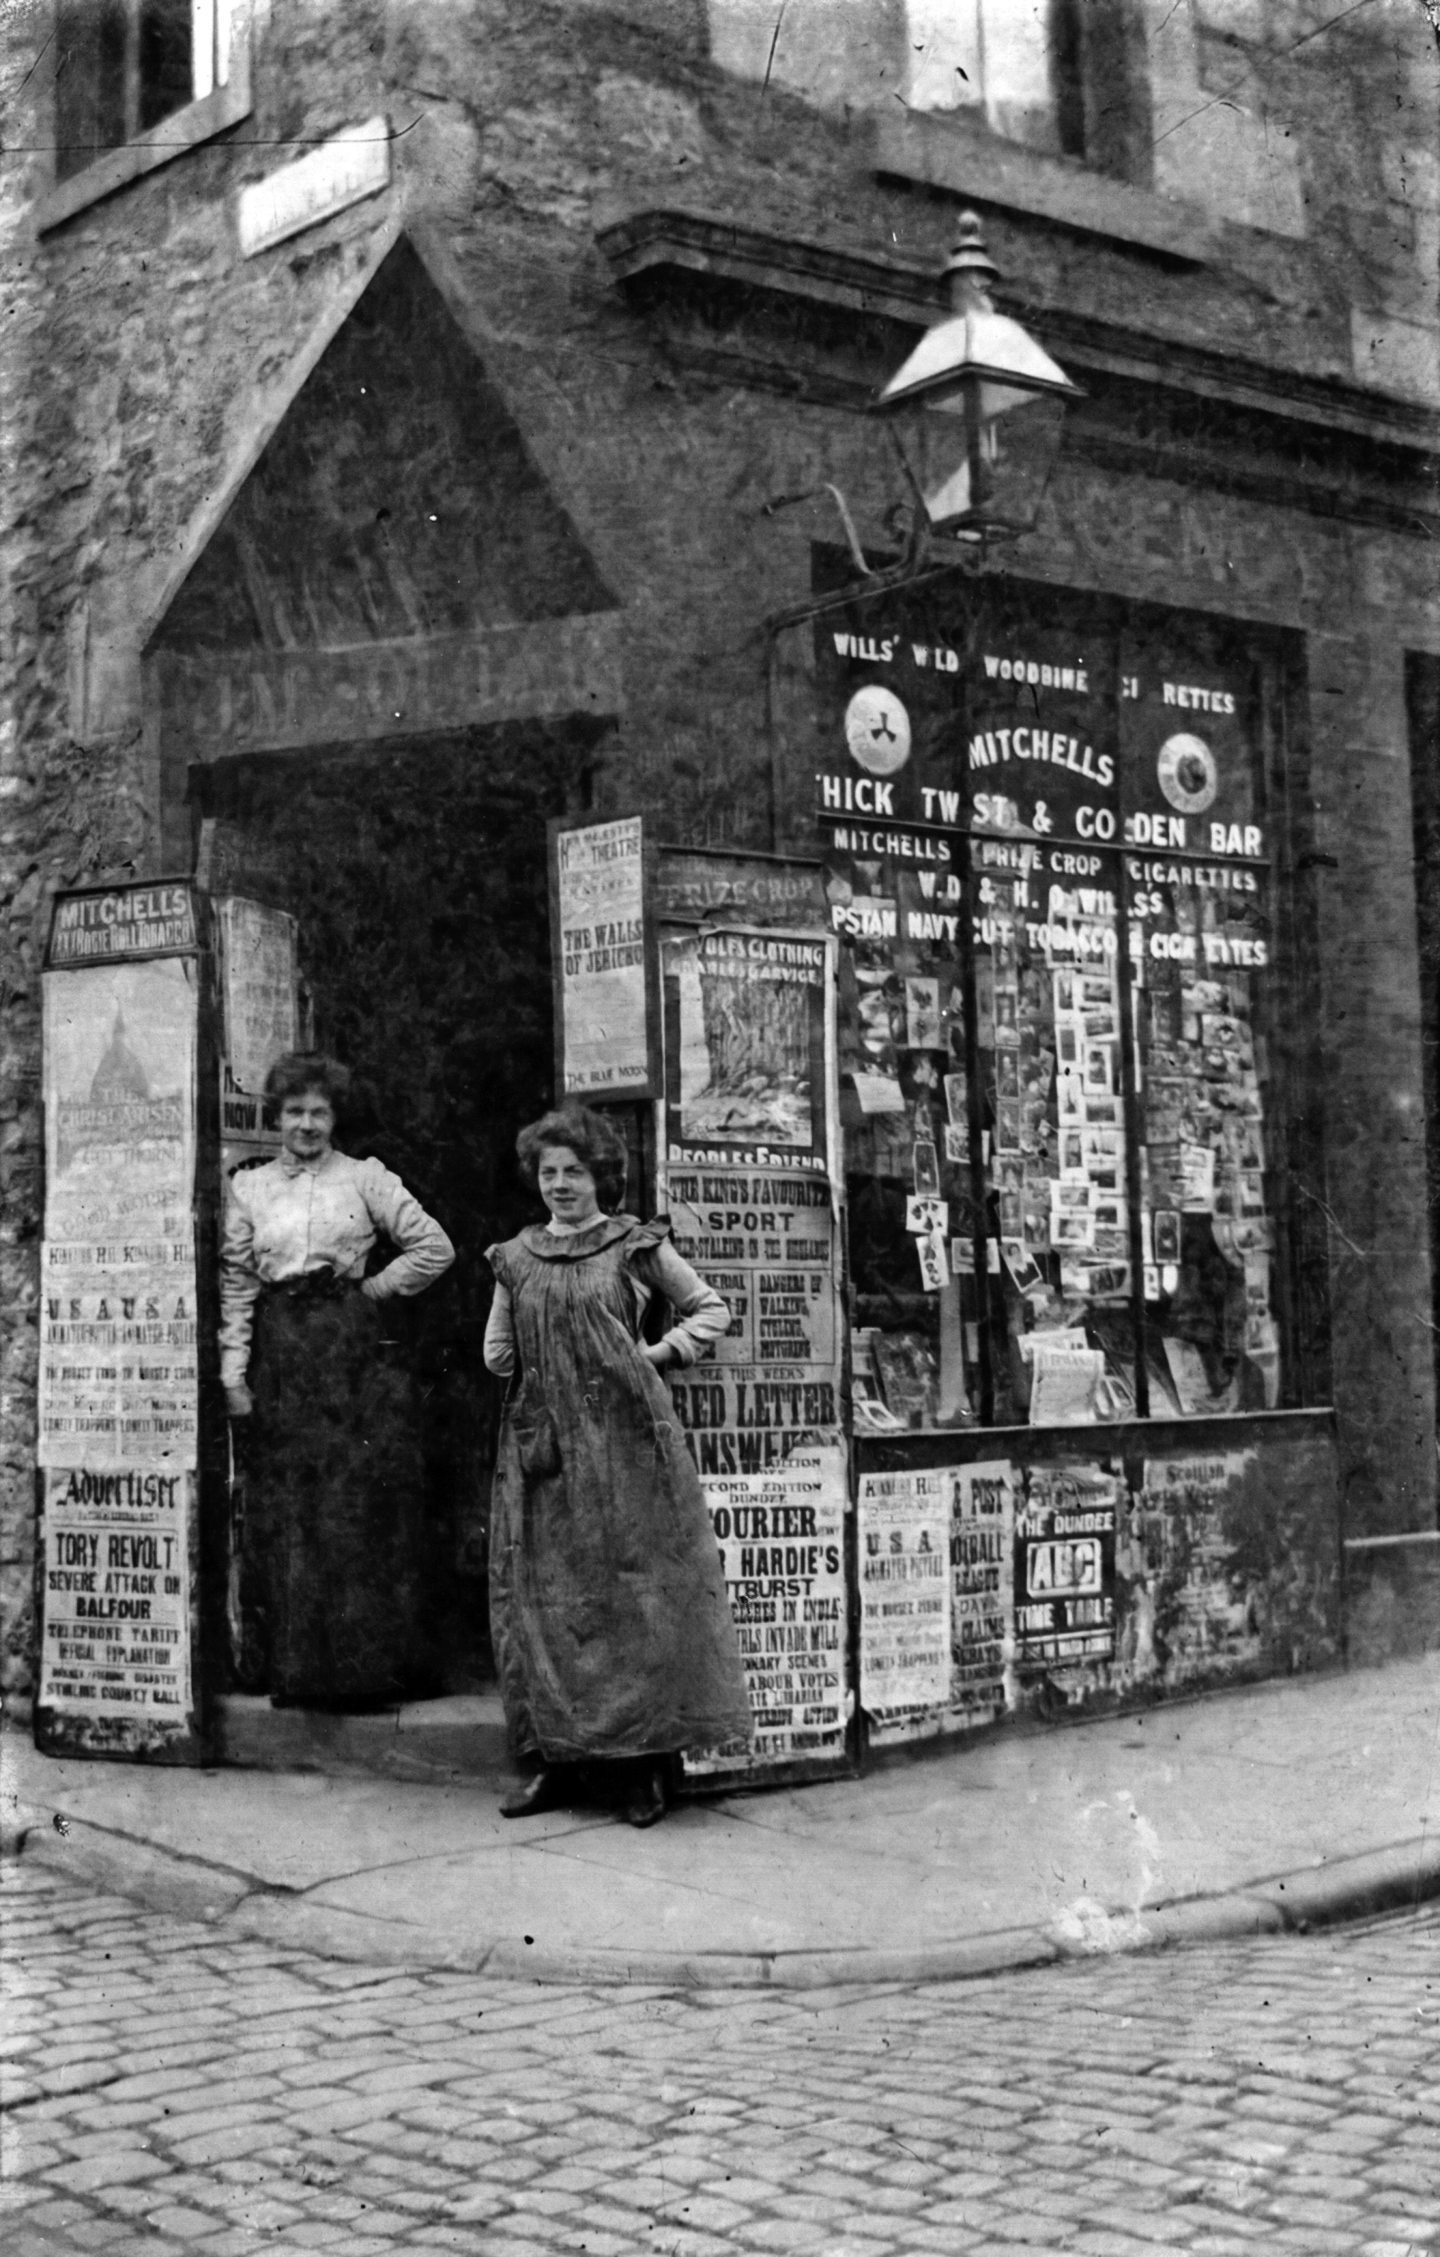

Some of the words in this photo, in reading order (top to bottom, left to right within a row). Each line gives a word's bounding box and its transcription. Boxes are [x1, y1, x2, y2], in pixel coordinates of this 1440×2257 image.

[833, 632, 900, 663] WILLS'
[911, 643, 959, 673] WLD
[983, 654, 1089, 693] WOODBINE
[1121, 676, 1235, 714] IRETTES
[968, 727, 1115, 787] MITCHELLS
[815, 774, 894, 816] HICK
[921, 786, 1009, 830] TWST
[1032, 800, 1053, 833] &
[1210, 822, 1262, 856] BAR
[833, 828, 952, 861] MITCHELLS
[1050, 851, 1102, 877] CROP
[1128, 860, 1257, 891] CIGARETTES
[564, 928, 592, 952] THE
[595, 918, 643, 947] WALLS
[908, 912, 959, 941] NAVY
[565, 954, 583, 976] OF
[586, 944, 644, 973] JERICHO
[748, 938, 823, 967] CLOTHING
[708, 1211, 795, 1232] SPORT
[671, 1384, 727, 1430] RED
[735, 1382, 838, 1428] LETTER
[56, 1467, 181, 1508] Advertiser
[761, 1481, 822, 1493] EDITION
[709, 1505, 818, 1539] OURIER
[1054, 1511, 1114, 1534] DUNDEE
[56, 1532, 99, 1568] TORY
[108, 1533, 175, 1570] REVOLT
[740, 1545, 840, 1578] HARDIE'S
[1031, 1543, 1094, 1590] ABC
[48, 1571, 97, 1593] SEVERE
[105, 1572, 157, 1595] ATTACK
[164, 1575, 181, 1595] ON
[76, 1597, 151, 1620] BALFOUR
[48, 1623, 122, 1641] TELEPHONE
[131, 1627, 180, 1644] TARIFF
[101, 1686, 147, 1704] COUNTY
